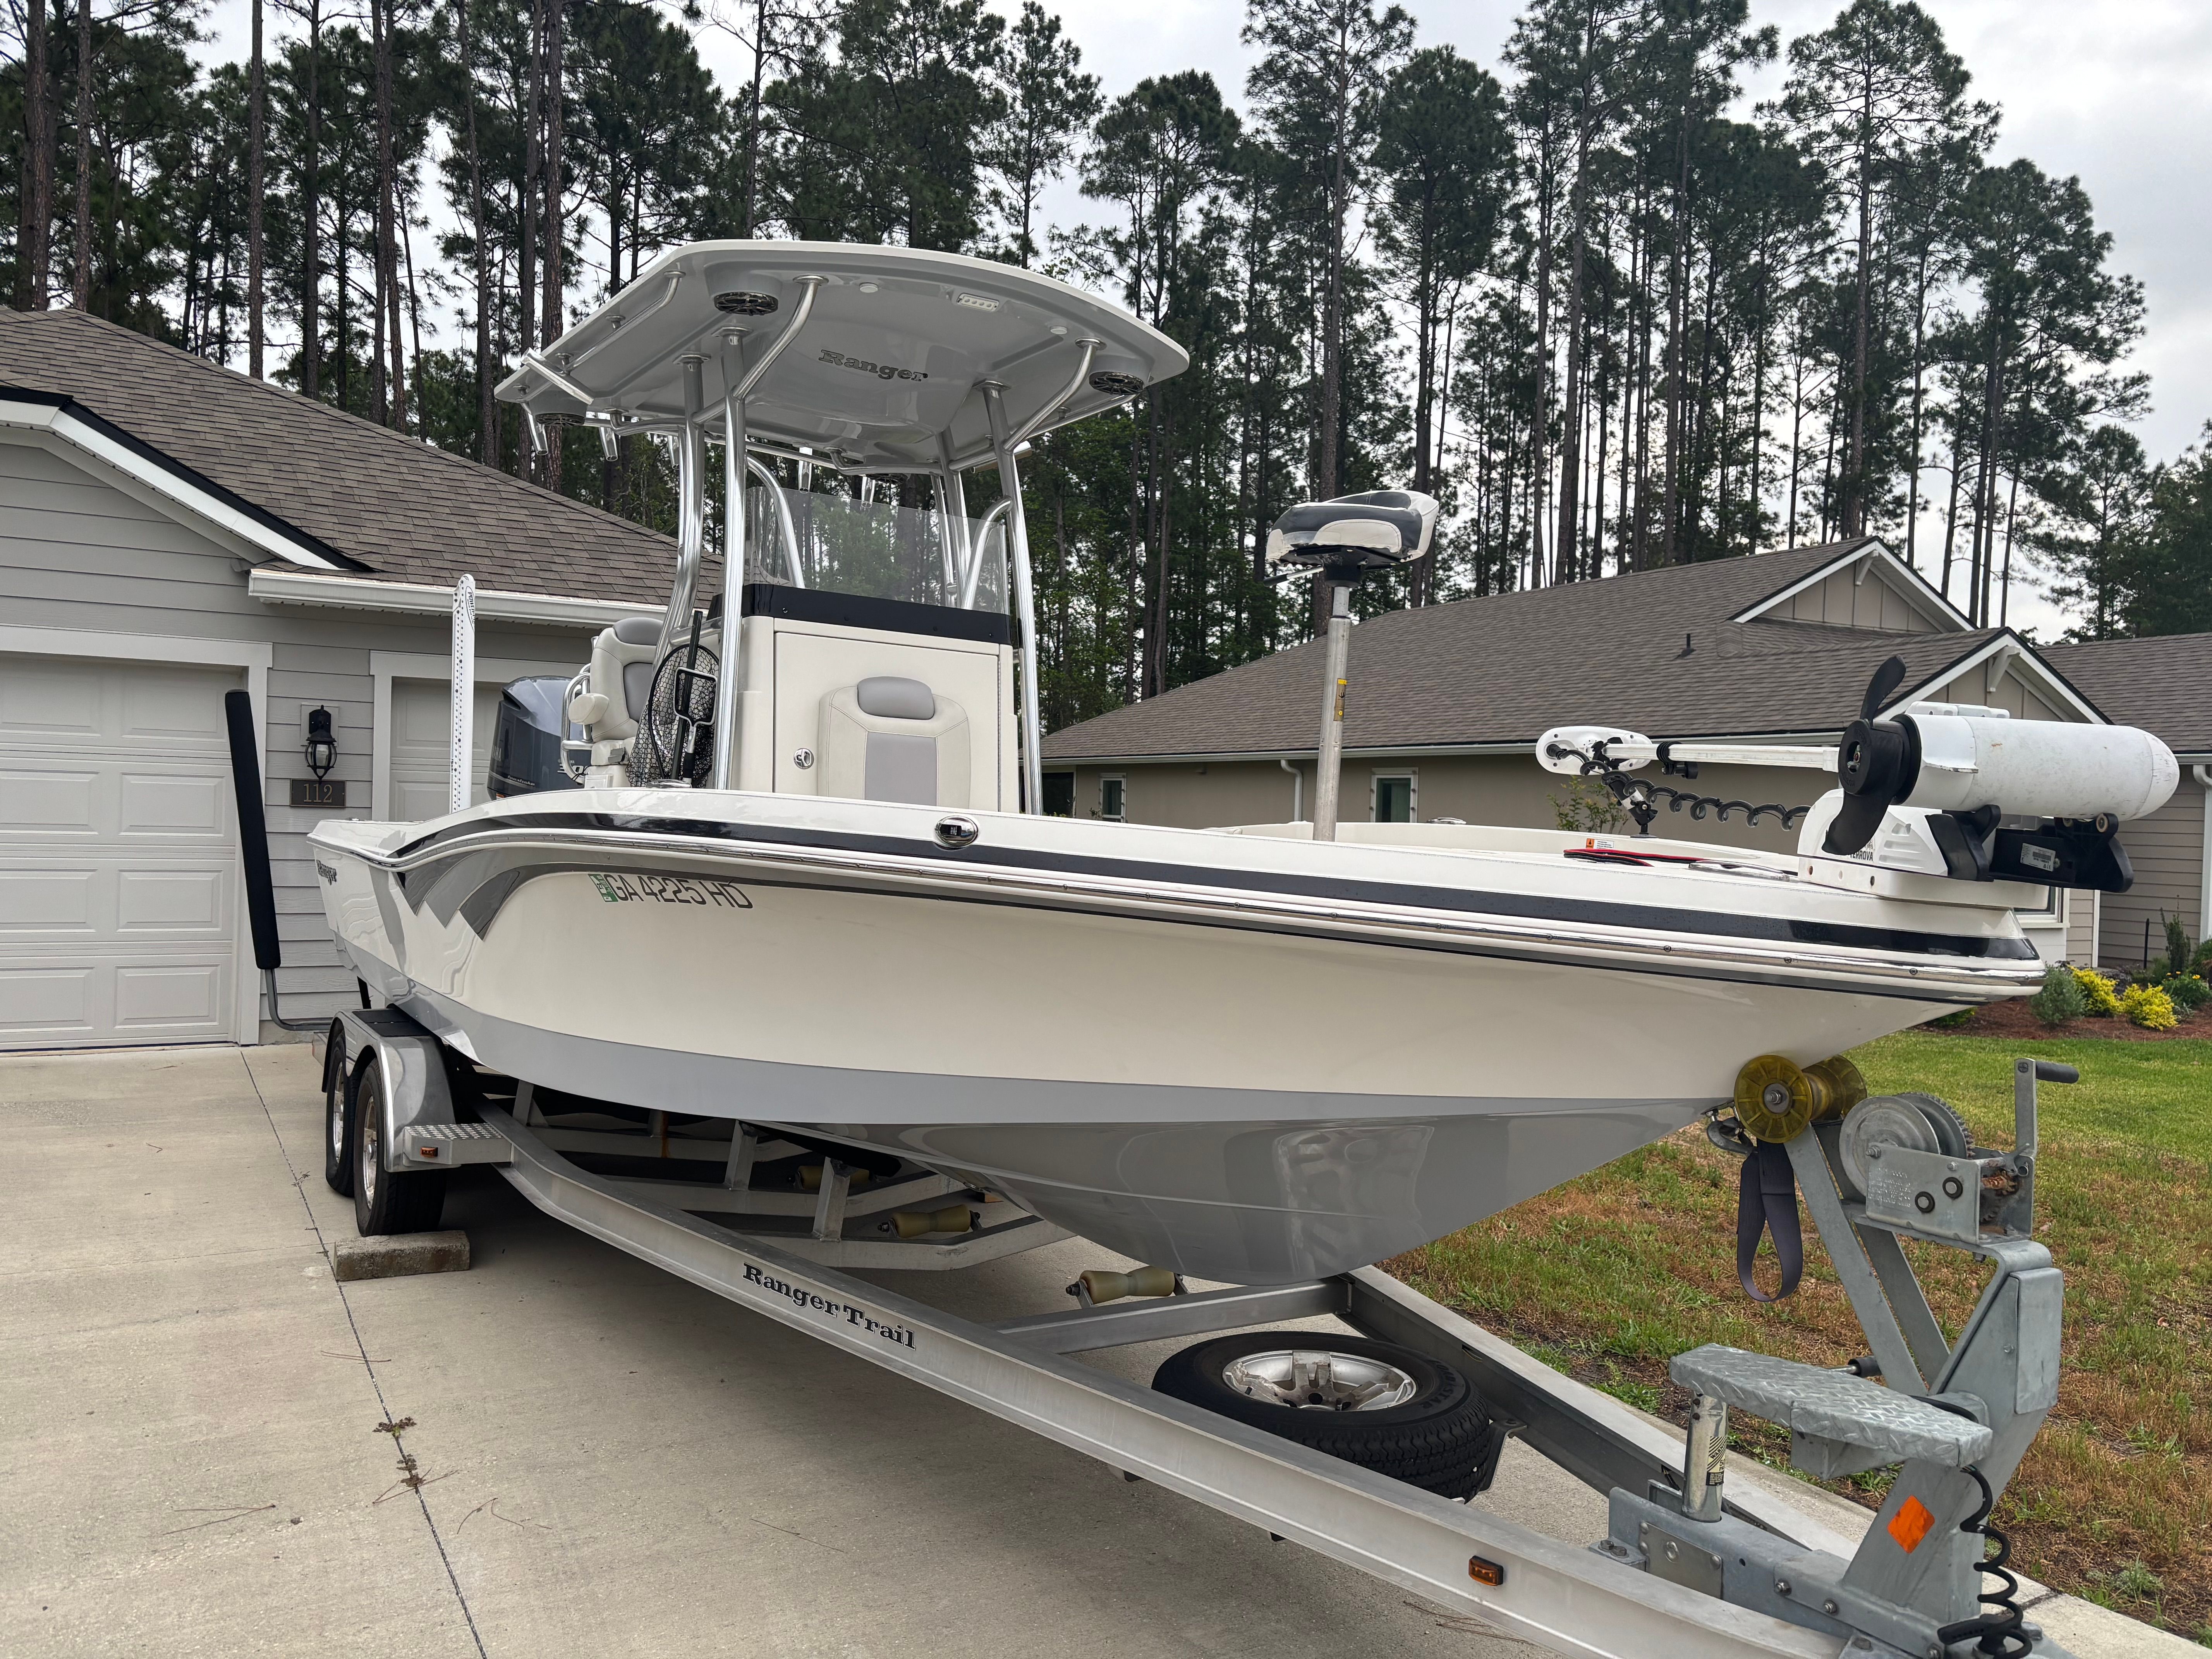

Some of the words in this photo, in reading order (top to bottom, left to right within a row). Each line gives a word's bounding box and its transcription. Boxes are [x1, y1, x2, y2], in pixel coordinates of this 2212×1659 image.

[818, 349, 928, 382] Ranger
[304, 783, 333, 803] 112
[316, 859, 337, 886] Ranger
[603, 874, 644, 902] GA
[637, 876, 707, 905] 4225
[699, 881, 753, 909] HD
